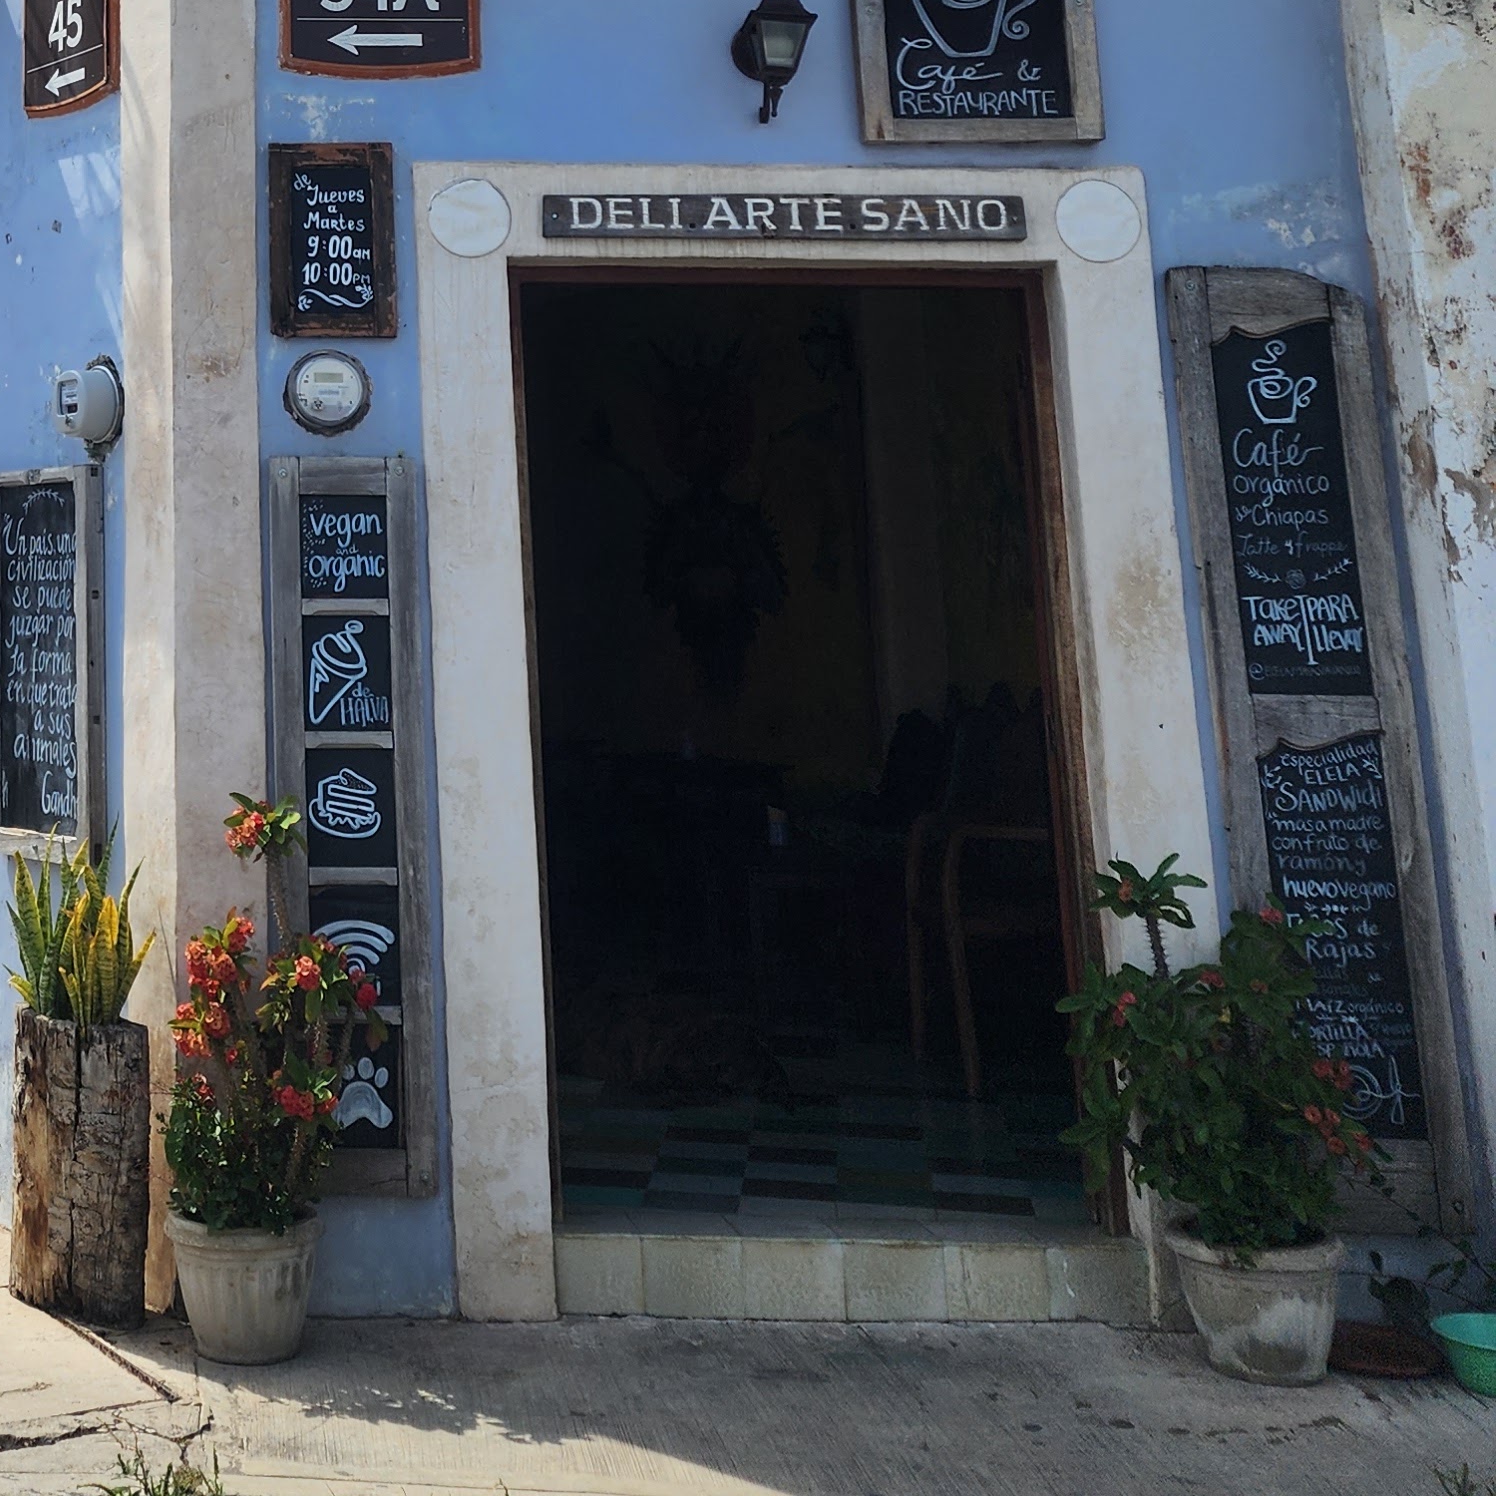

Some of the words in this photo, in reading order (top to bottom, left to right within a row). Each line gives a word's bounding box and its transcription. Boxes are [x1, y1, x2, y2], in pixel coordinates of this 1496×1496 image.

[896, 37, 1003, 94] Café
[1017, 59, 1041, 82] &
[898, 88, 1059, 117] RESTAURANTE
[294, 173, 311, 191] de
[307, 185, 365, 206] Jueves
[327, 205, 338, 214] a
[569, 196, 683, 231] DELI
[703, 196, 844, 232] ARTE
[861, 197, 1008, 232] SANO
[1233, 428, 1324, 477] Café
[1235, 505, 1252, 523] de
[1253, 505, 1329, 531] Chiapas
[336, 544, 359, 555] and
[37, 585, 73, 614] puede
[1306, 593, 1360, 624] PARA
[5, 615, 54, 648] juzgar
[1253, 622, 1305, 652] AWAY
[31, 648, 73, 682] forma
[352, 682, 374, 697] de
[33, 710, 45, 732] a
[49, 712, 72, 740] sus
[1280, 740, 1379, 775] especialidad
[1305, 766, 1361, 786] ELELA
[1356, 835, 1383, 853] de
[1283, 875, 1338, 901] huevo
[1357, 920, 1381, 938] de
[1306, 938, 1377, 968] Rajas
